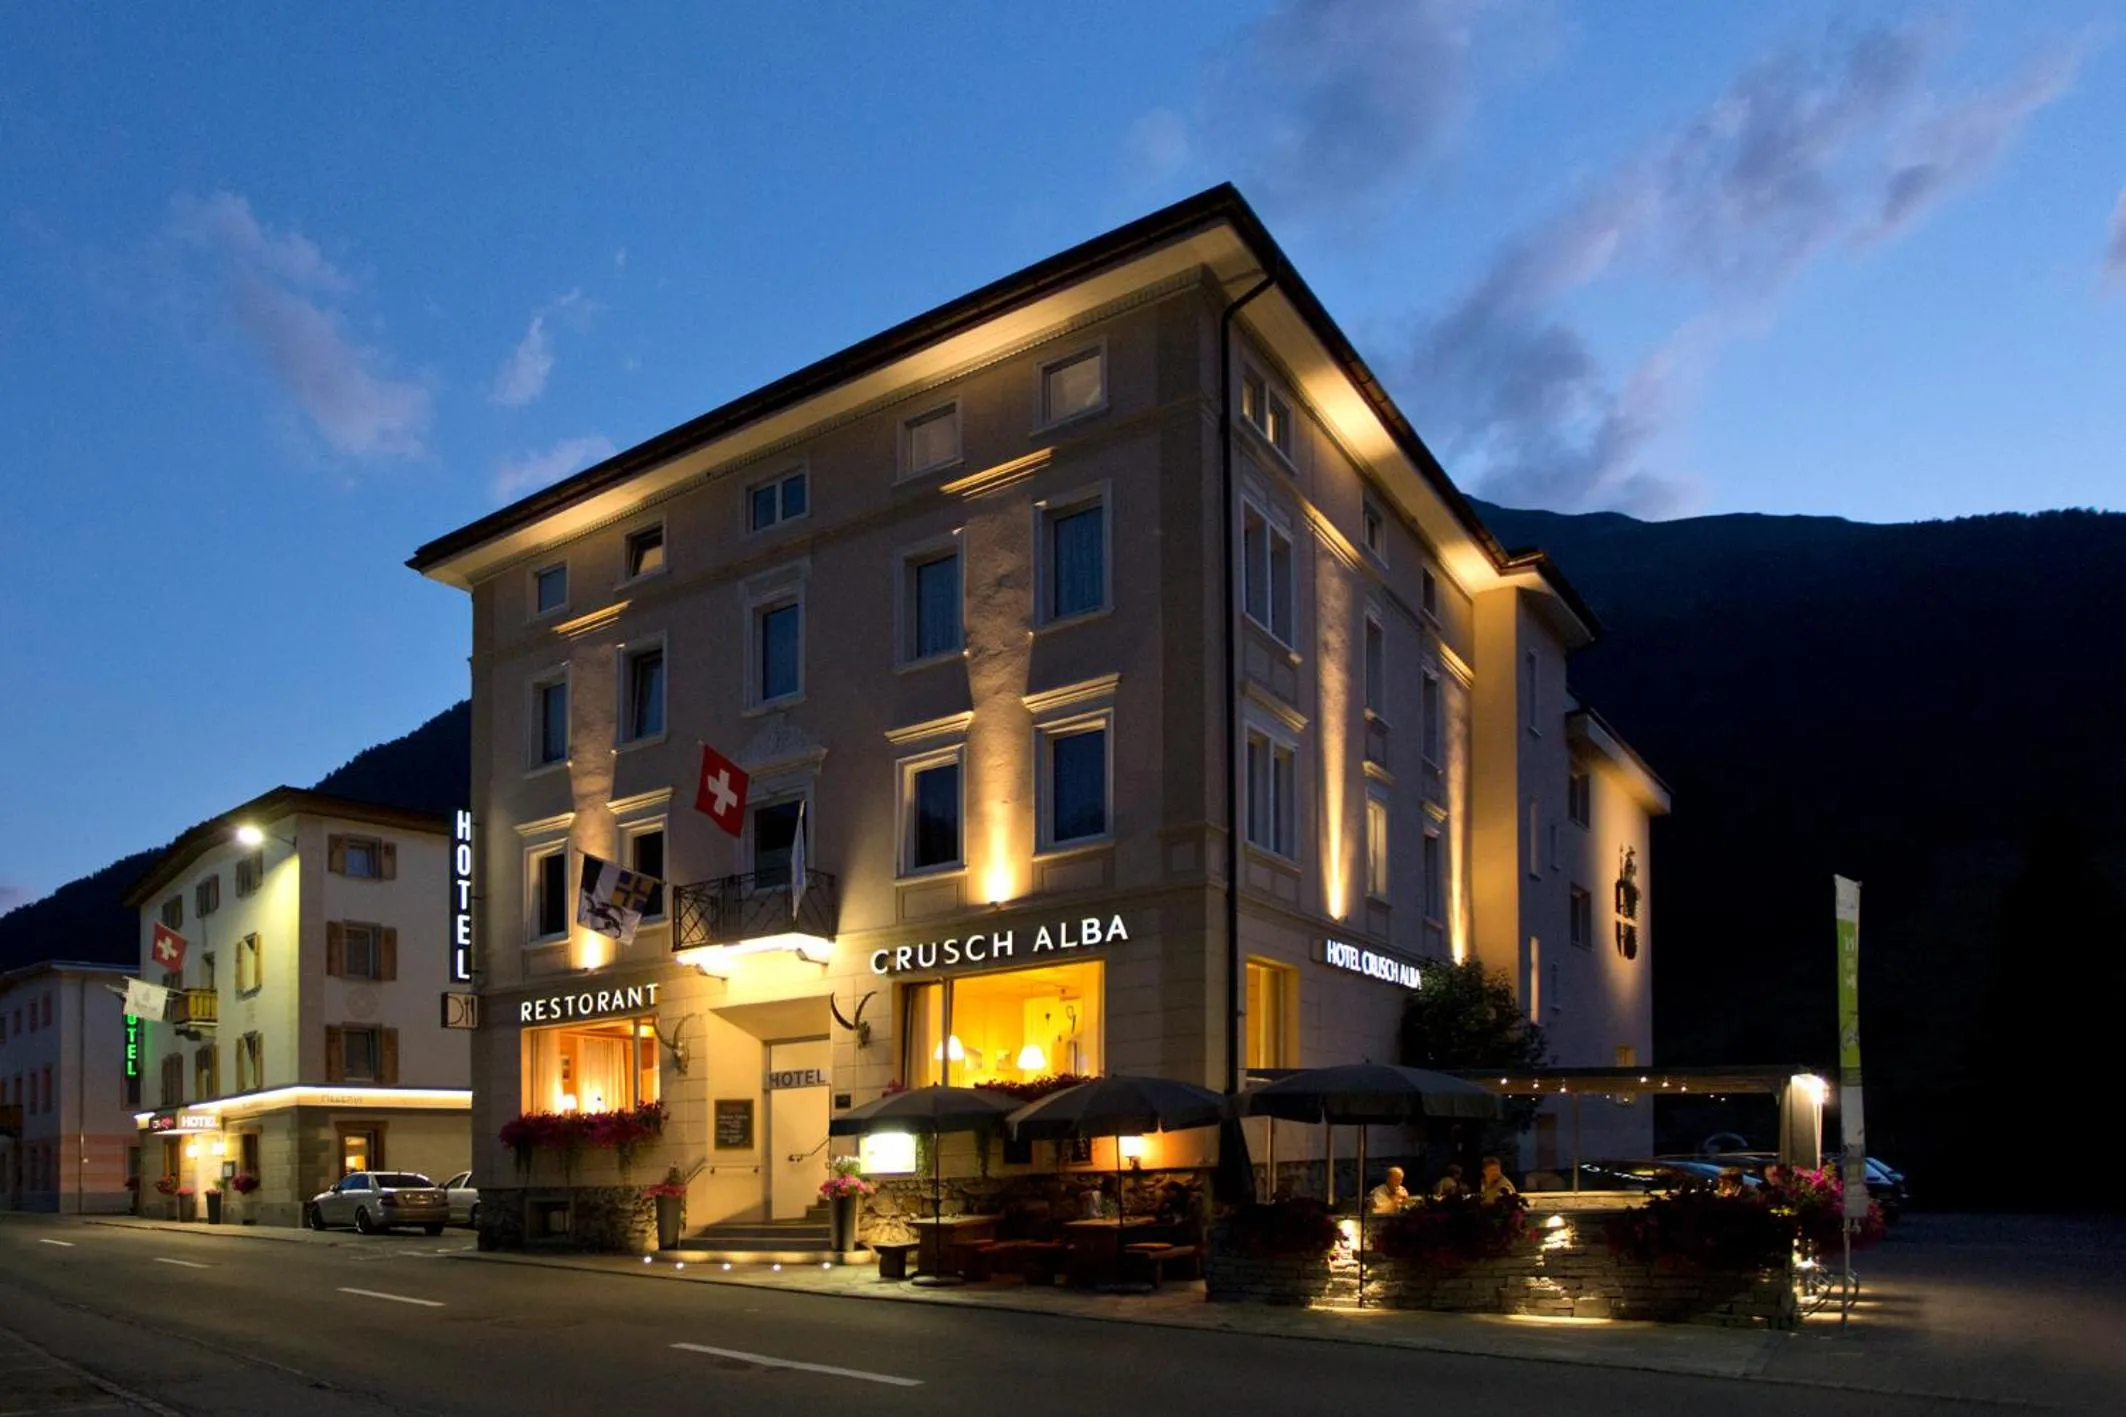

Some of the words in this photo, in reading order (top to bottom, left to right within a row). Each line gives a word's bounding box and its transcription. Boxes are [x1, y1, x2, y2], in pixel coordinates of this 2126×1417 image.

[456, 809, 471, 980] HOTEL
[869, 931, 1013, 975] CRUSCH
[1033, 914, 1129, 952] ALBA
[1326, 939, 1361, 972] HOTEL
[520, 983, 658, 1021] RESTORANT
[126, 1012, 137, 1076] OTEL
[769, 1069, 826, 1087] HOTEL
[181, 1115, 219, 1128] HOTEL
